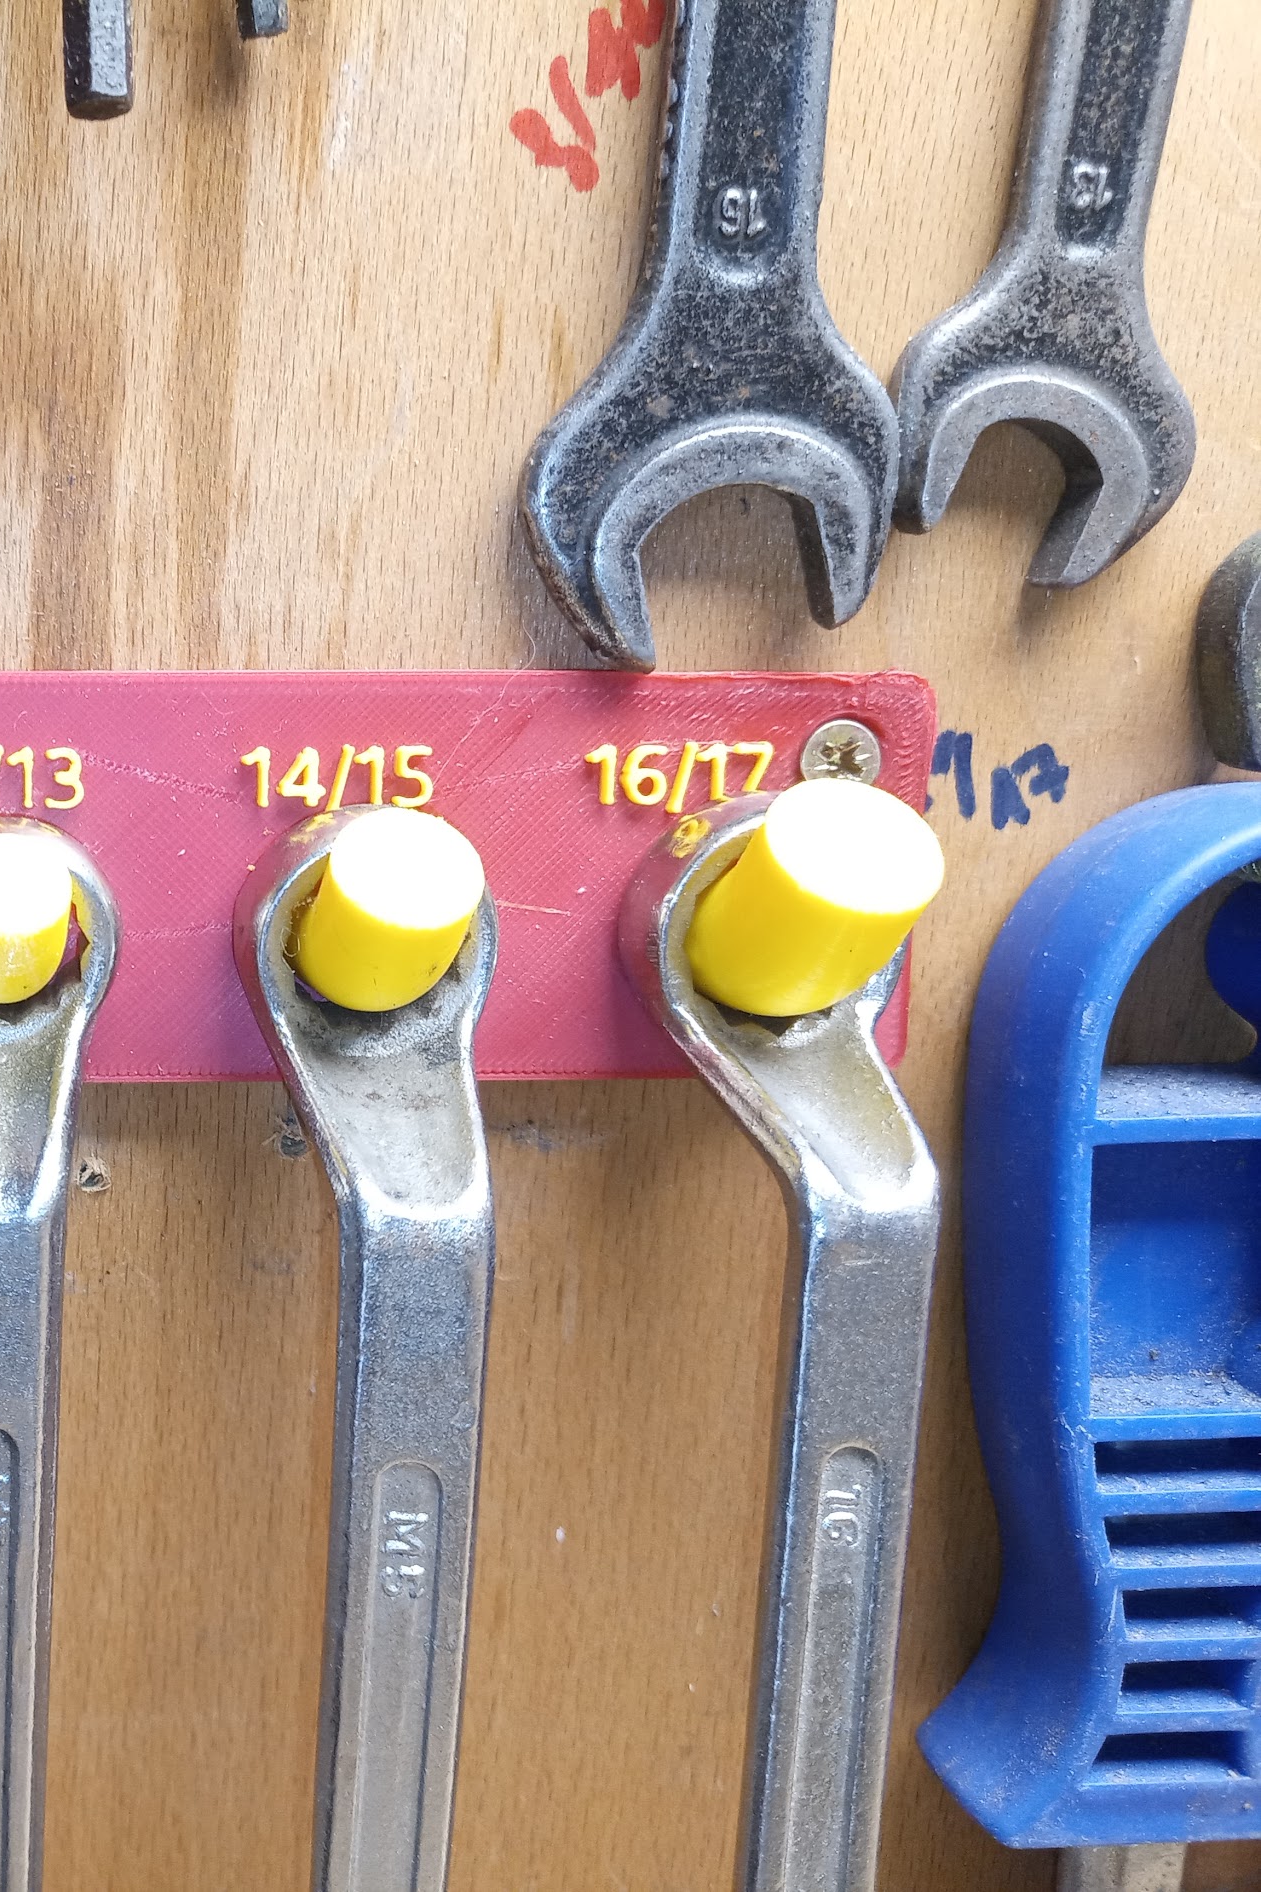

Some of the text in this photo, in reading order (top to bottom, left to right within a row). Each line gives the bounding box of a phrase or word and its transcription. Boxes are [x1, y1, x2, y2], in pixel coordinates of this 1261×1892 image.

[715, 184, 767, 239] 16
[239, 744, 434, 812] 14/15
[584, 743, 774, 813] 16/17
